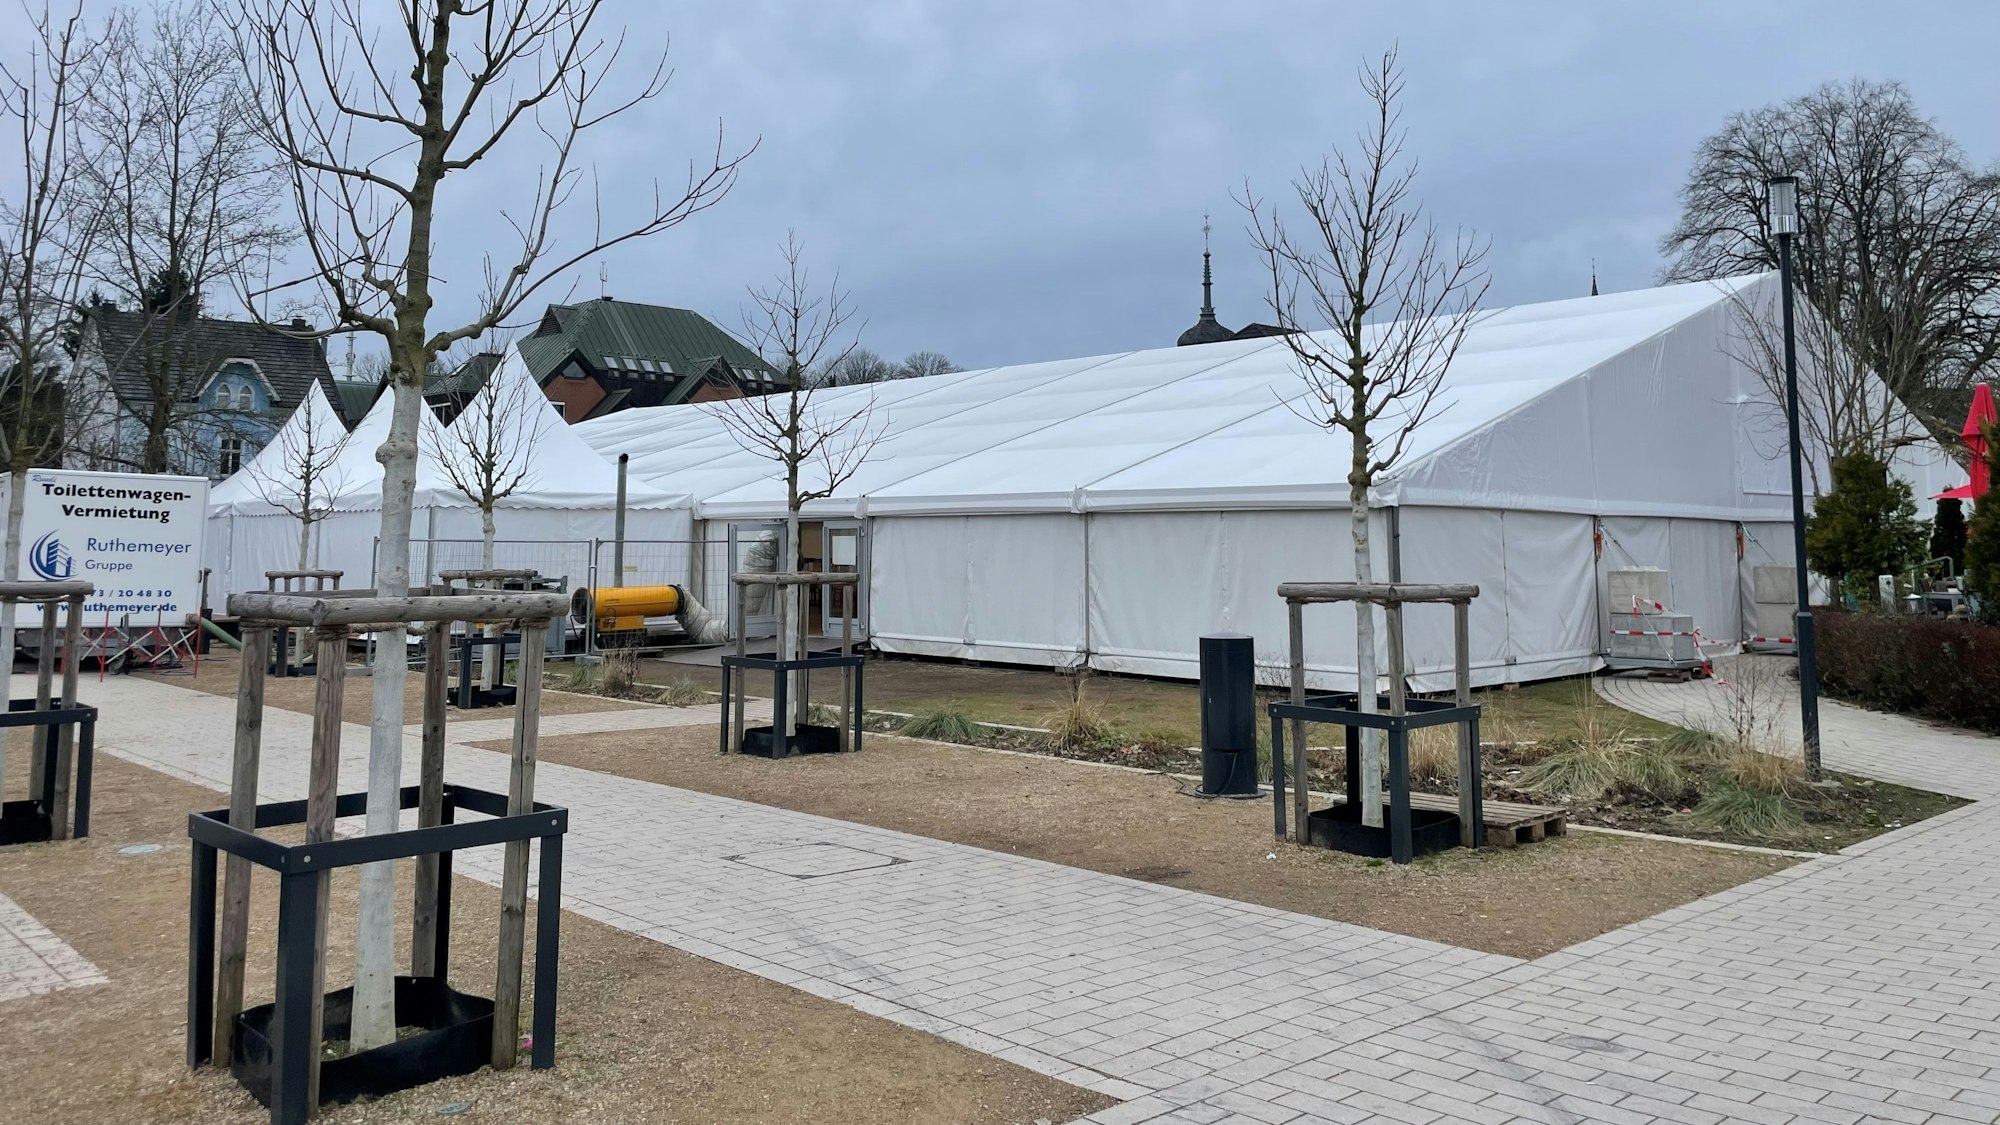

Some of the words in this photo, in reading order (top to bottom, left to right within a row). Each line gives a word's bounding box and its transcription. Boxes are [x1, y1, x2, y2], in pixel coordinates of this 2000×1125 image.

[43, 484, 191, 504] Toilettenwagen-
[62, 505, 170, 523] Vermietung
[87, 538, 191, 556] Ruthemeyer
[86, 560, 133, 572] Gruppe
[118, 590, 133, 598] 20
[137, 590, 152, 598] 48
[157, 590, 172, 598] 30
